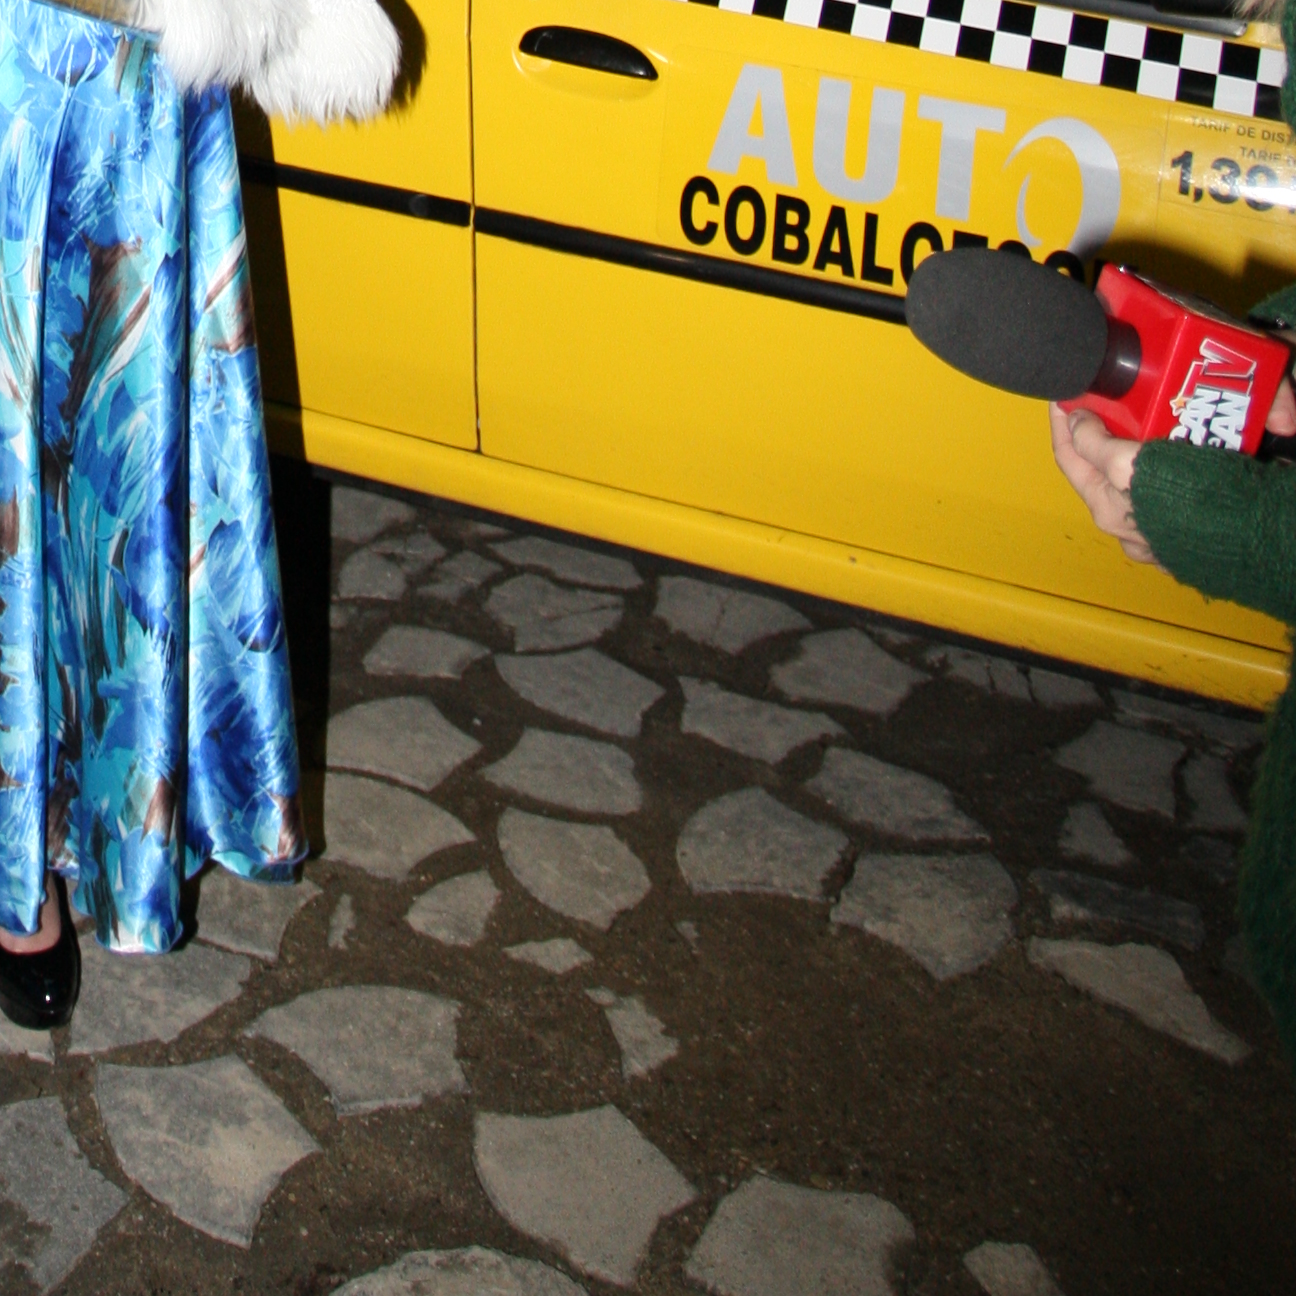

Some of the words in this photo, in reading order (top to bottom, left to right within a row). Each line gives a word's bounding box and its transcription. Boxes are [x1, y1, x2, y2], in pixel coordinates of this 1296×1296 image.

[707, 63, 1121, 255] AUTO
[1236, 124, 1257, 140] DE
[679, 176, 1108, 293] COBALC
